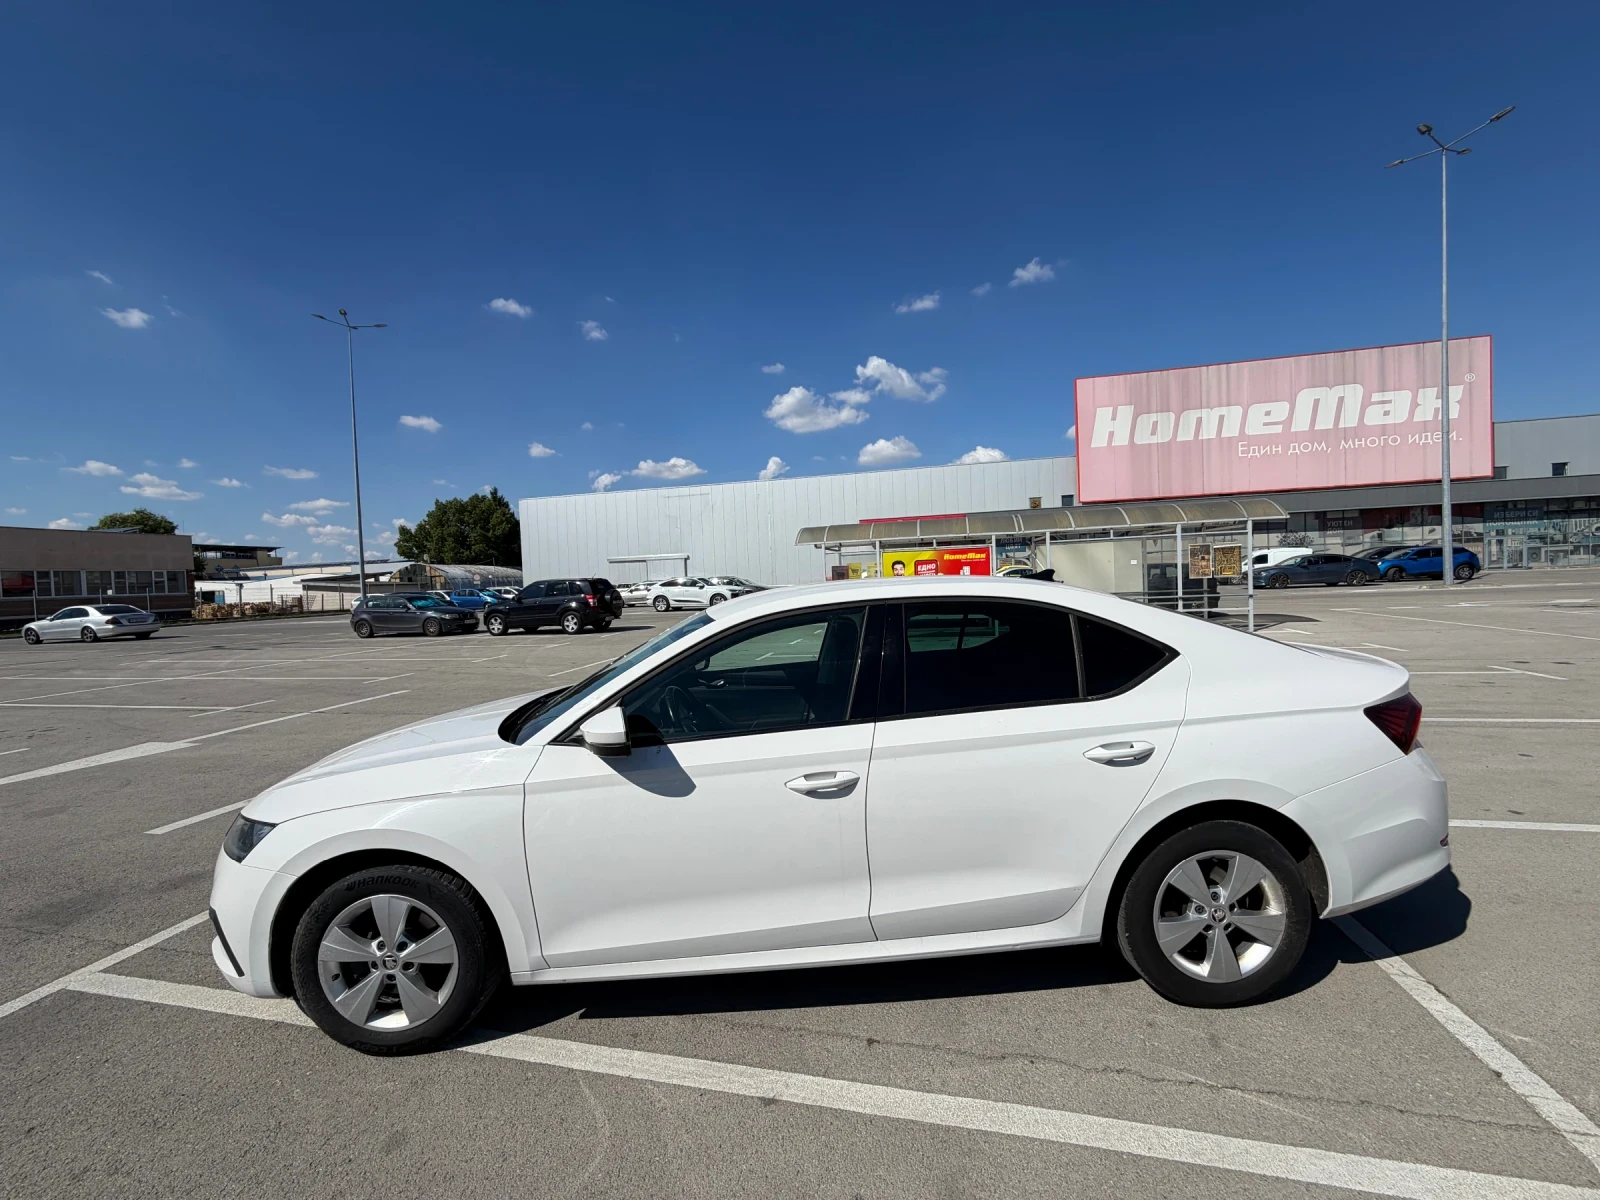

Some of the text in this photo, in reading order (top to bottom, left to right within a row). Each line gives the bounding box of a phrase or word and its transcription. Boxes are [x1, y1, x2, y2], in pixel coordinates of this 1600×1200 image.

[1091, 384, 1464, 448] HomeMax
[1238, 441, 1282, 458] Един
[1288, 440, 1332, 455] дом,
[1340, 434, 1400, 449] много
[1494, 510, 1526, 518] ИЗБЕРИ
[943, 552, 986, 560] HomeMax
[917, 563, 936, 572] ЕДНО
